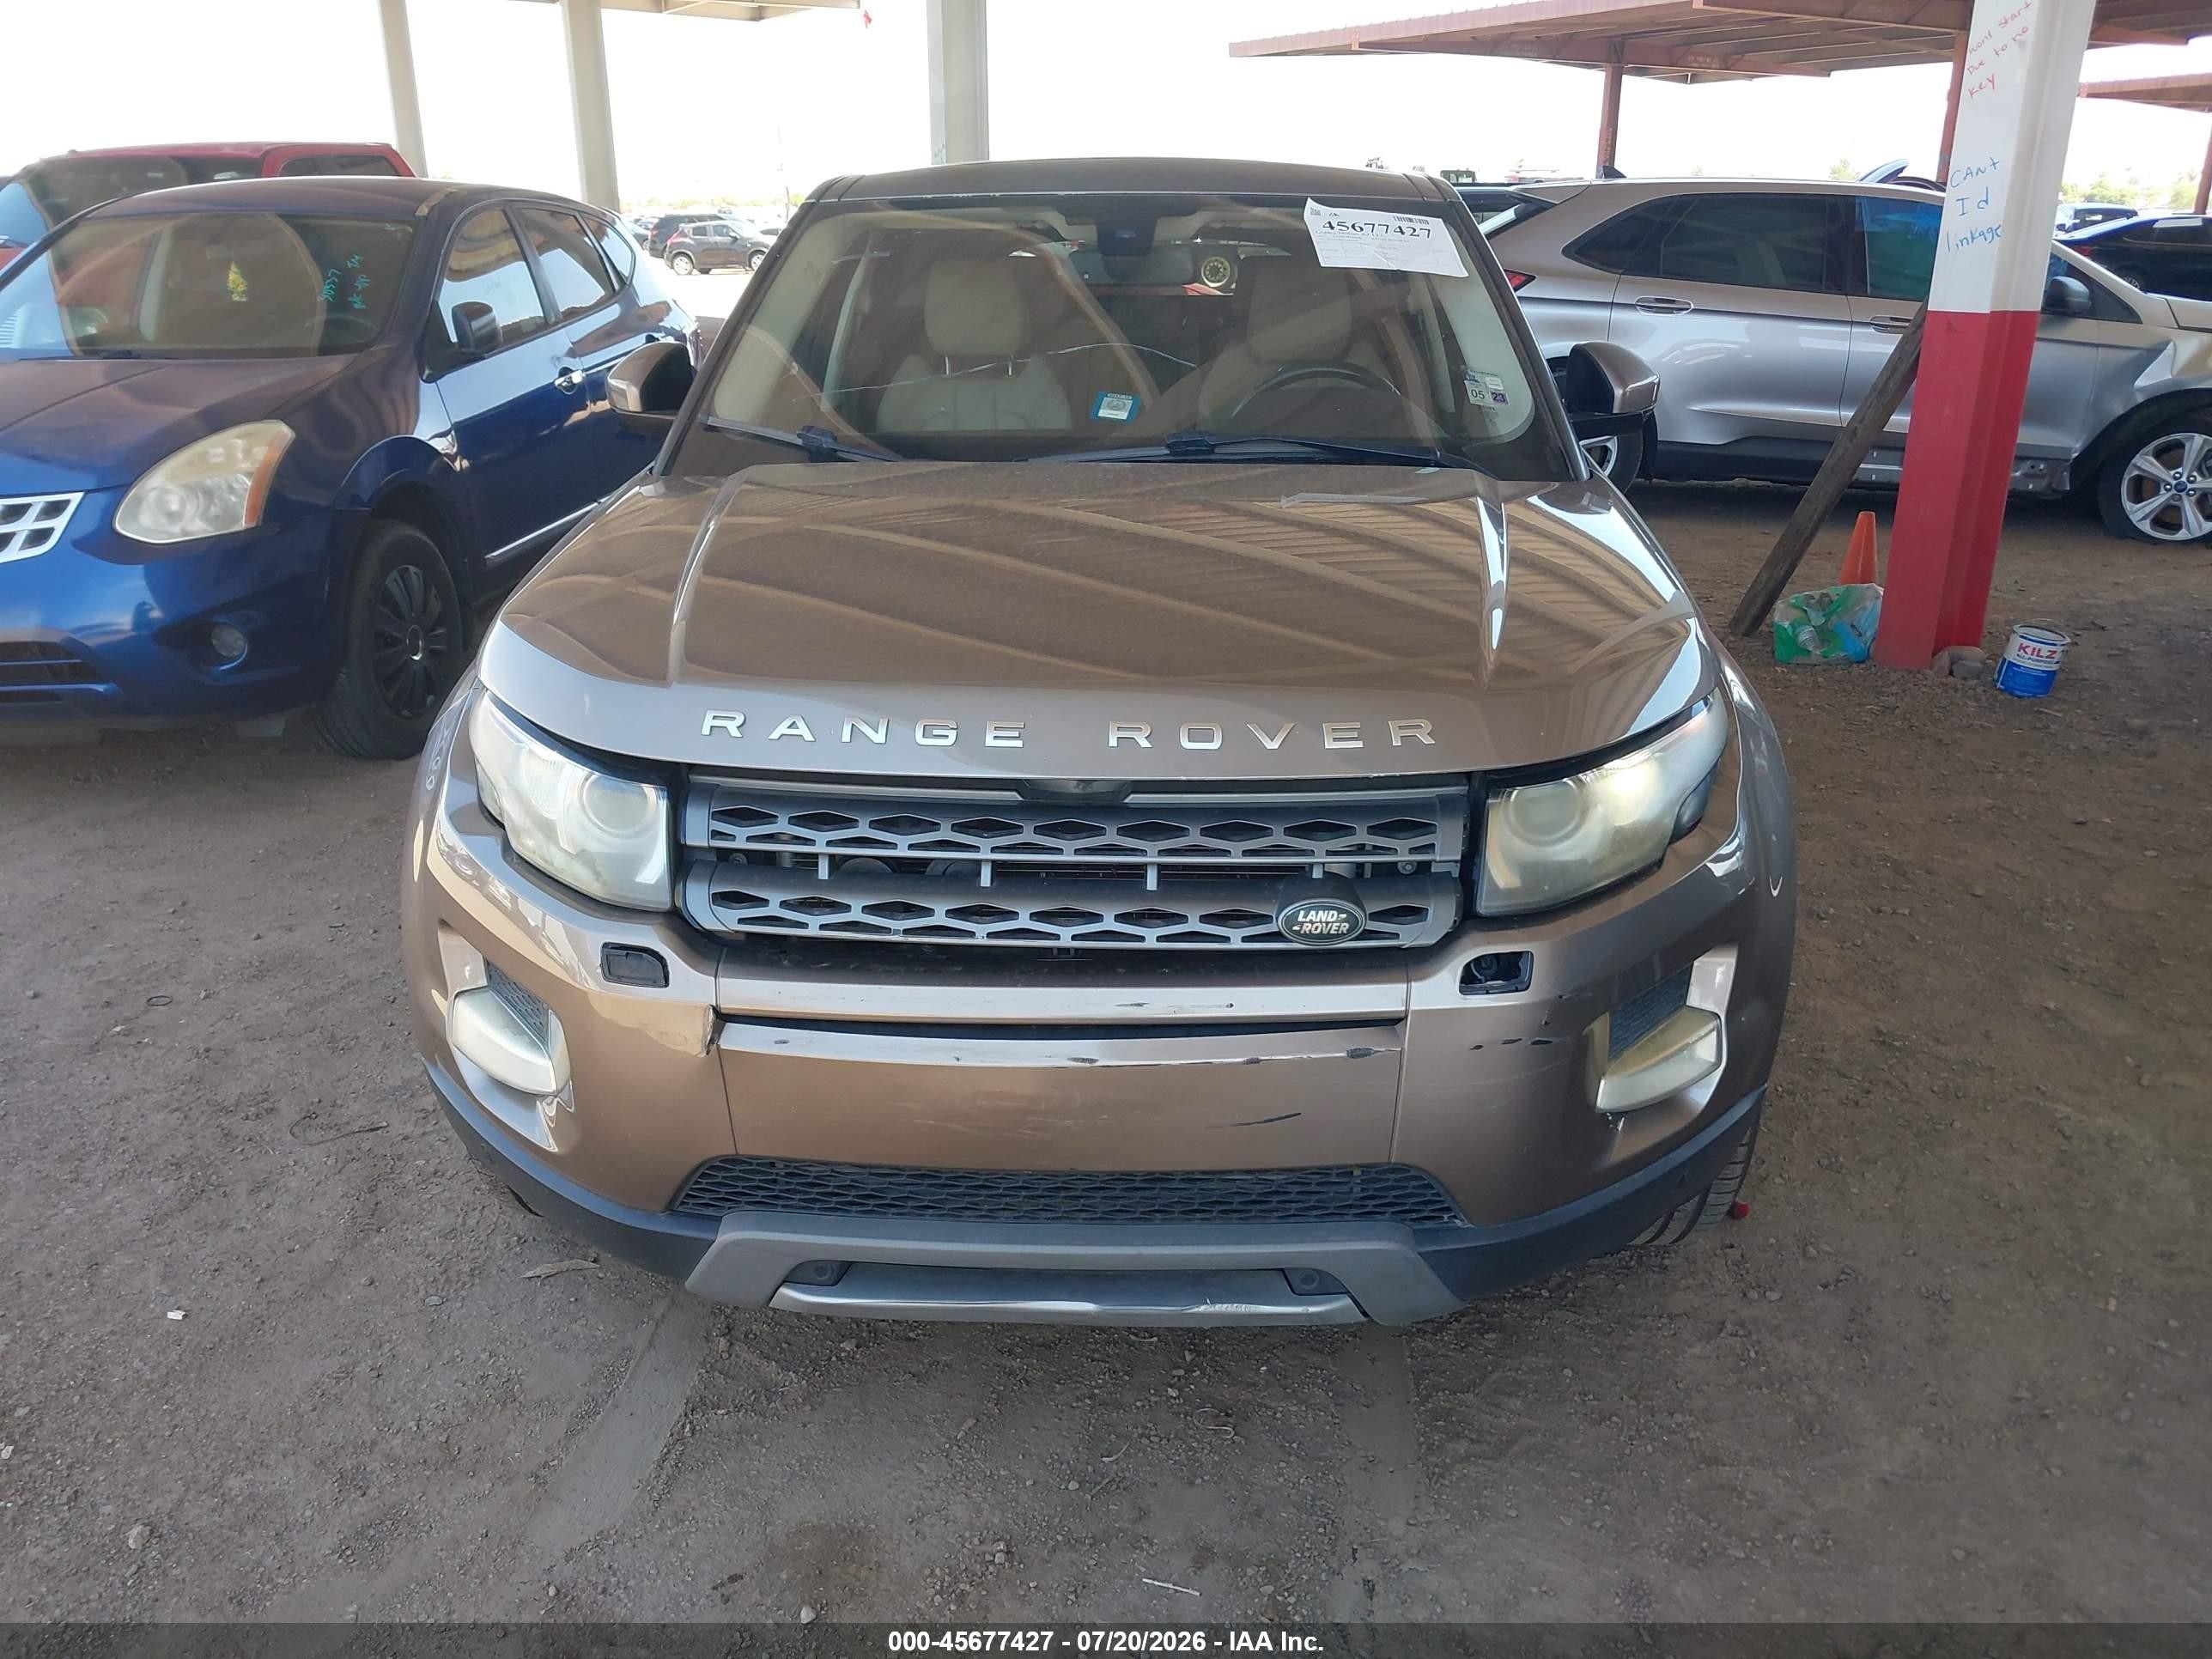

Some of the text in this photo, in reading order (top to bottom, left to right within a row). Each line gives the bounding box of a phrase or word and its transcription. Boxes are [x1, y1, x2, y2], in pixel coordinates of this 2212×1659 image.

[1993, 43, 2008, 57] to
[1322, 220, 1431, 239] 45677427
[1470, 389, 1506, 403] 05 23
[2018, 642, 2058, 659] KILZ
[701, 708, 1437, 750] RANGE ROVER
[1297, 909, 1338, 922] LAND
[1300, 922, 1350, 934] ROVER
